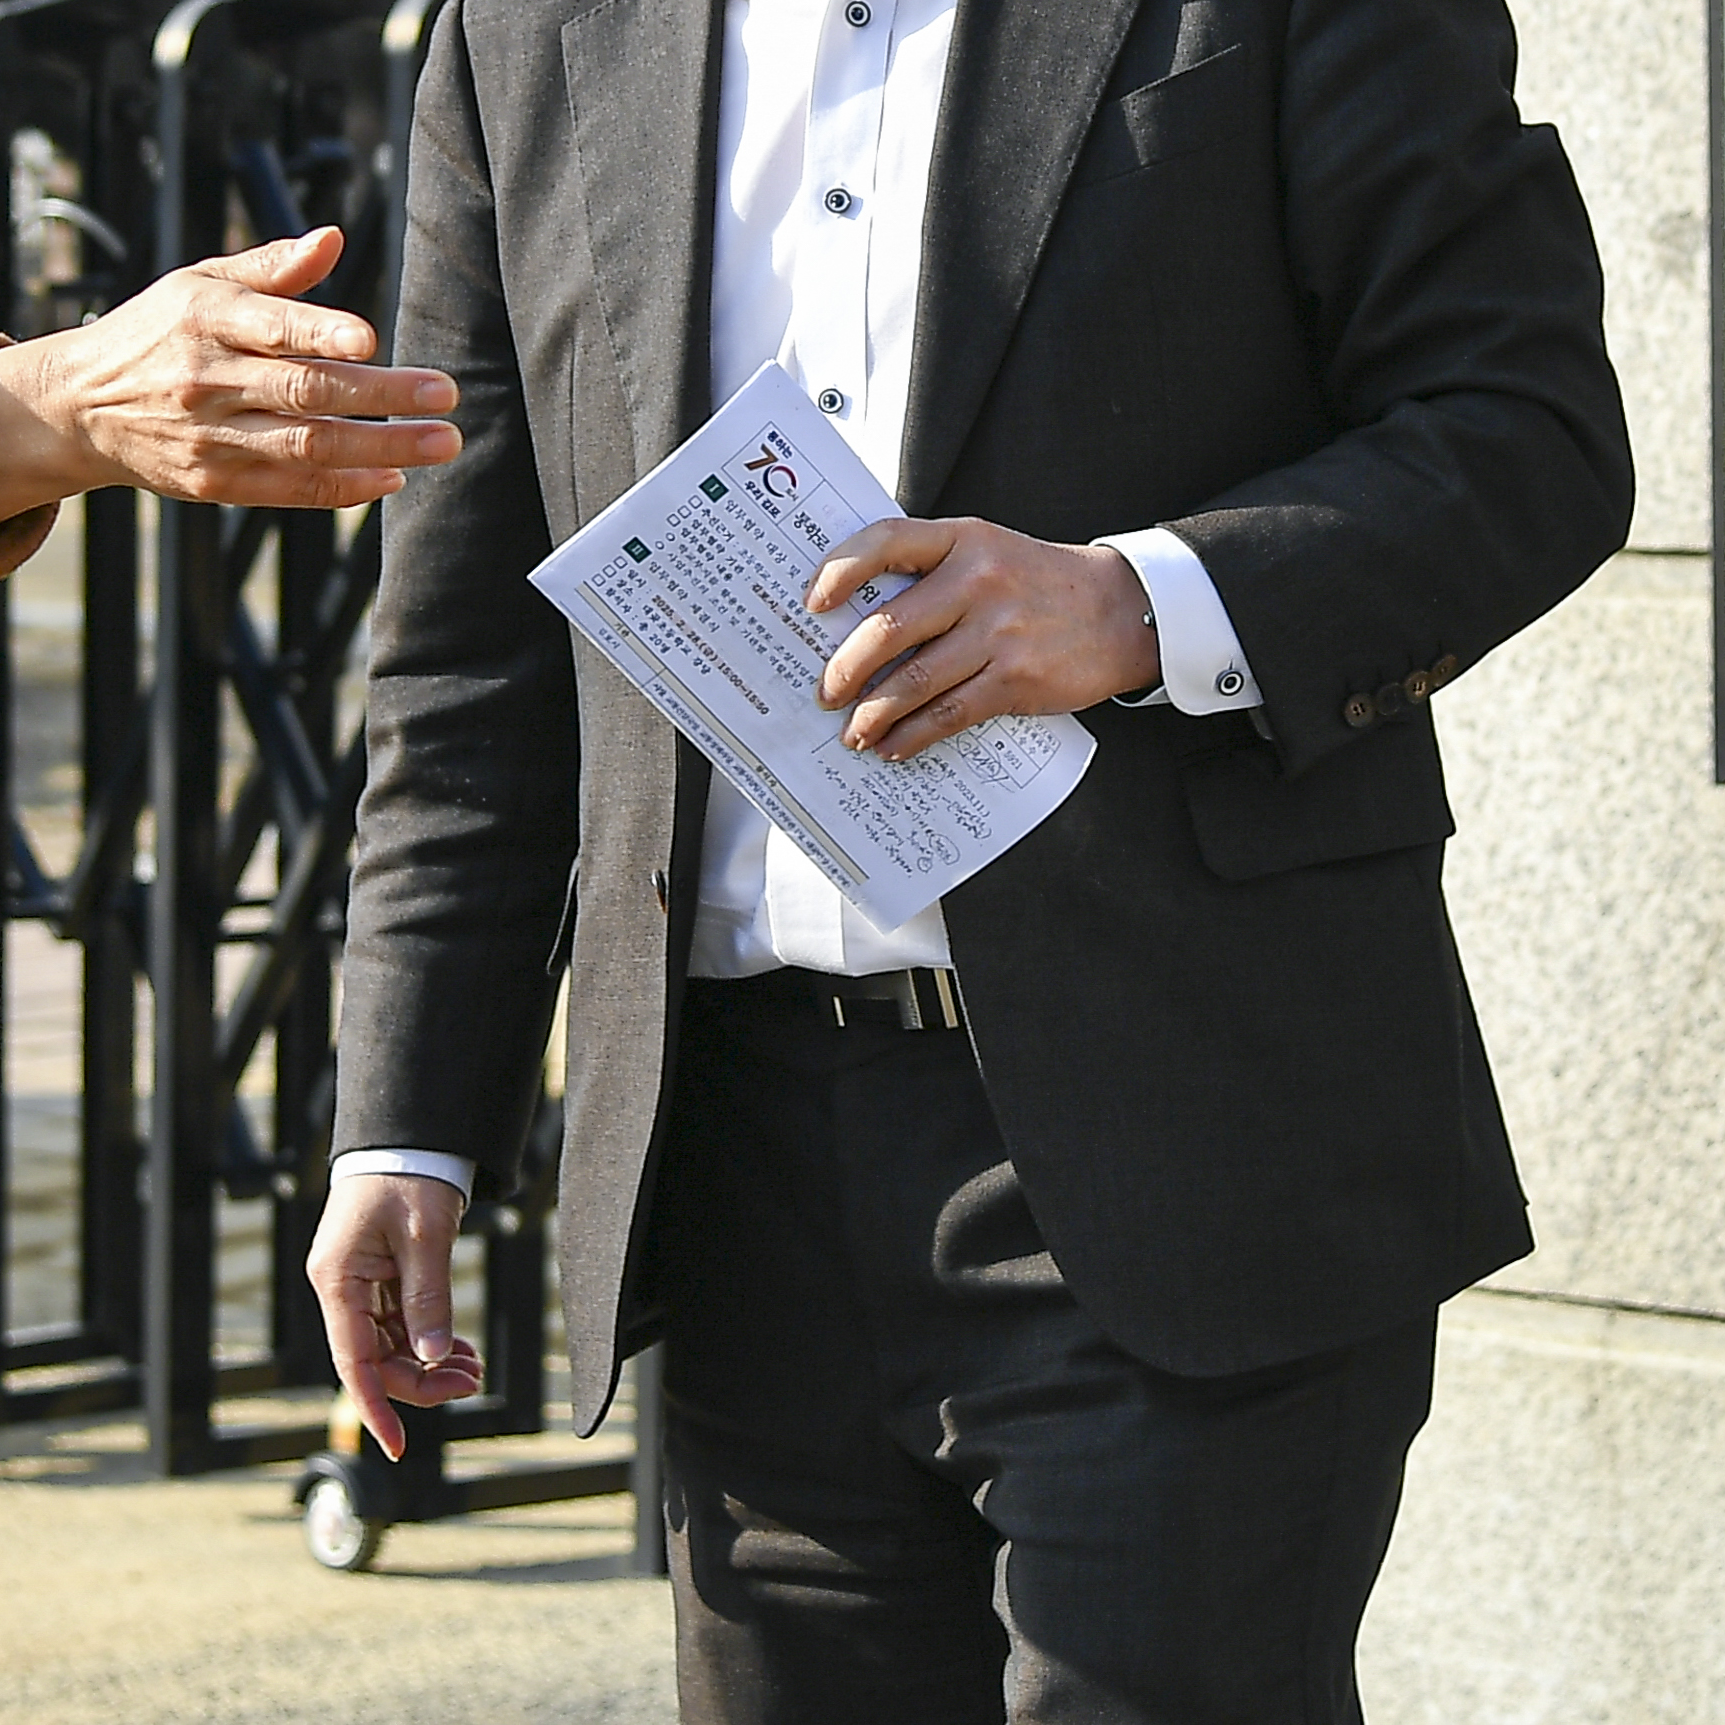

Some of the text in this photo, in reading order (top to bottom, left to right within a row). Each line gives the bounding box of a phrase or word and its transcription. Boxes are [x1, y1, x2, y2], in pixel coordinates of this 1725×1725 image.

[767, 430, 793, 459] 통하는
[744, 480, 781, 519] 우리 김포
[680, 527, 715, 562] 업무협약
[691, 519, 726, 554] 업무협약
[725, 499, 801, 579] 업무협약 대상 및
[793, 511, 831, 553] 통학로
[648, 561, 689, 601] 업무협약
